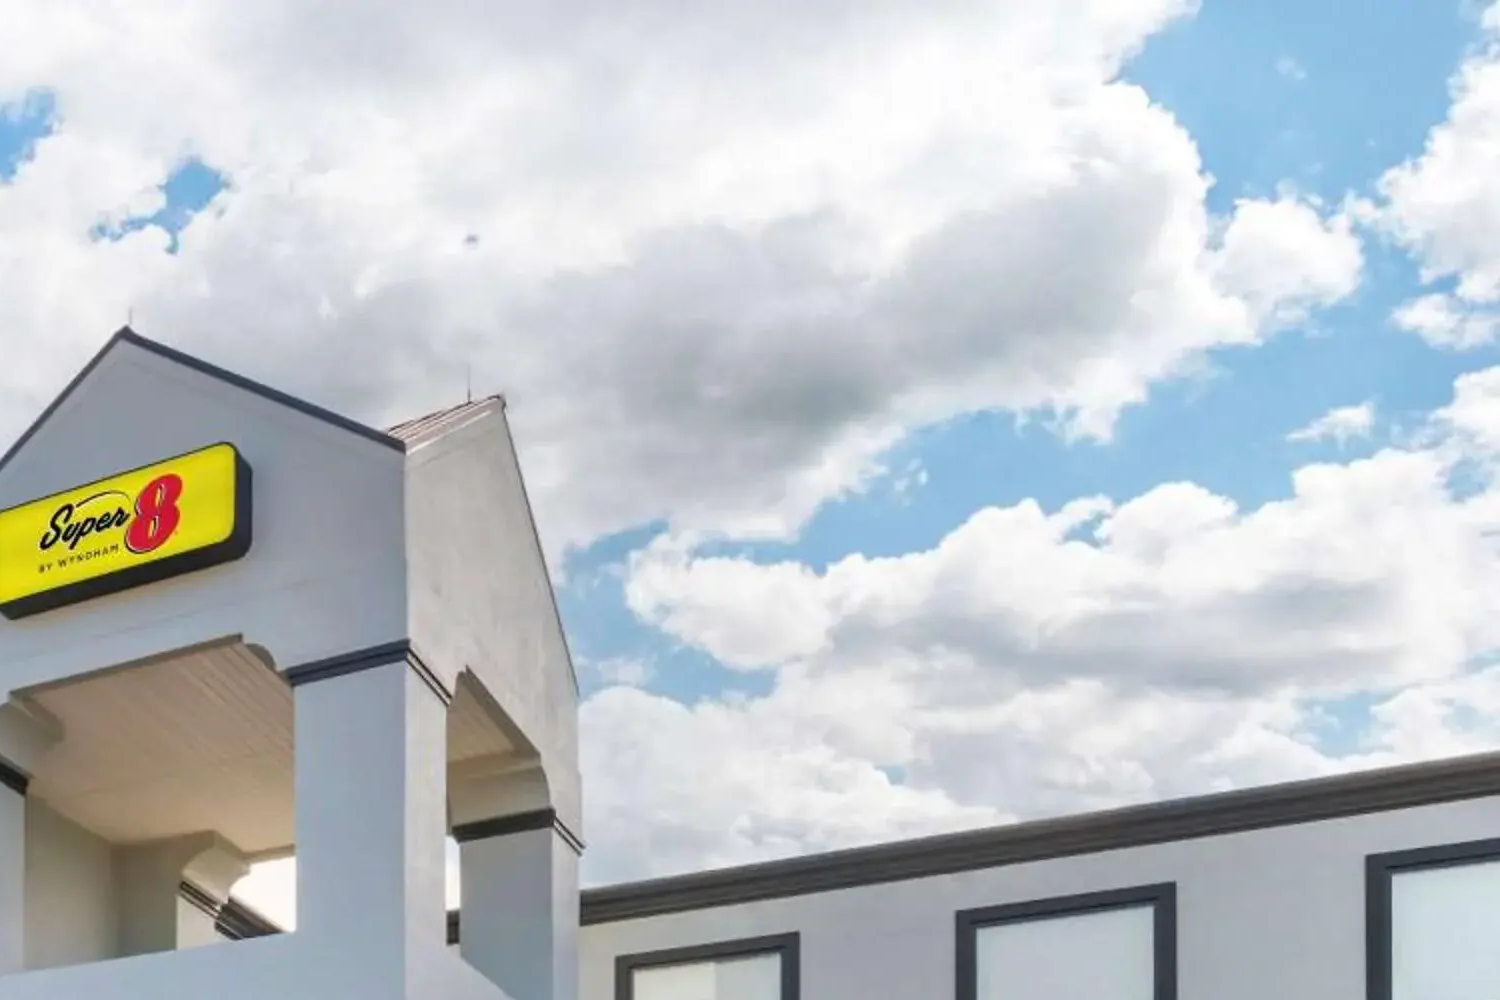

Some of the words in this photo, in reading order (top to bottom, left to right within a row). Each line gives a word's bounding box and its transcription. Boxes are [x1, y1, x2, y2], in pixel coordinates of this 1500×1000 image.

[40, 502, 130, 550] Super
[125, 474, 183, 553] 8
[38, 563, 53, 574] BY
[58, 544, 118, 567] WYNDHAM
